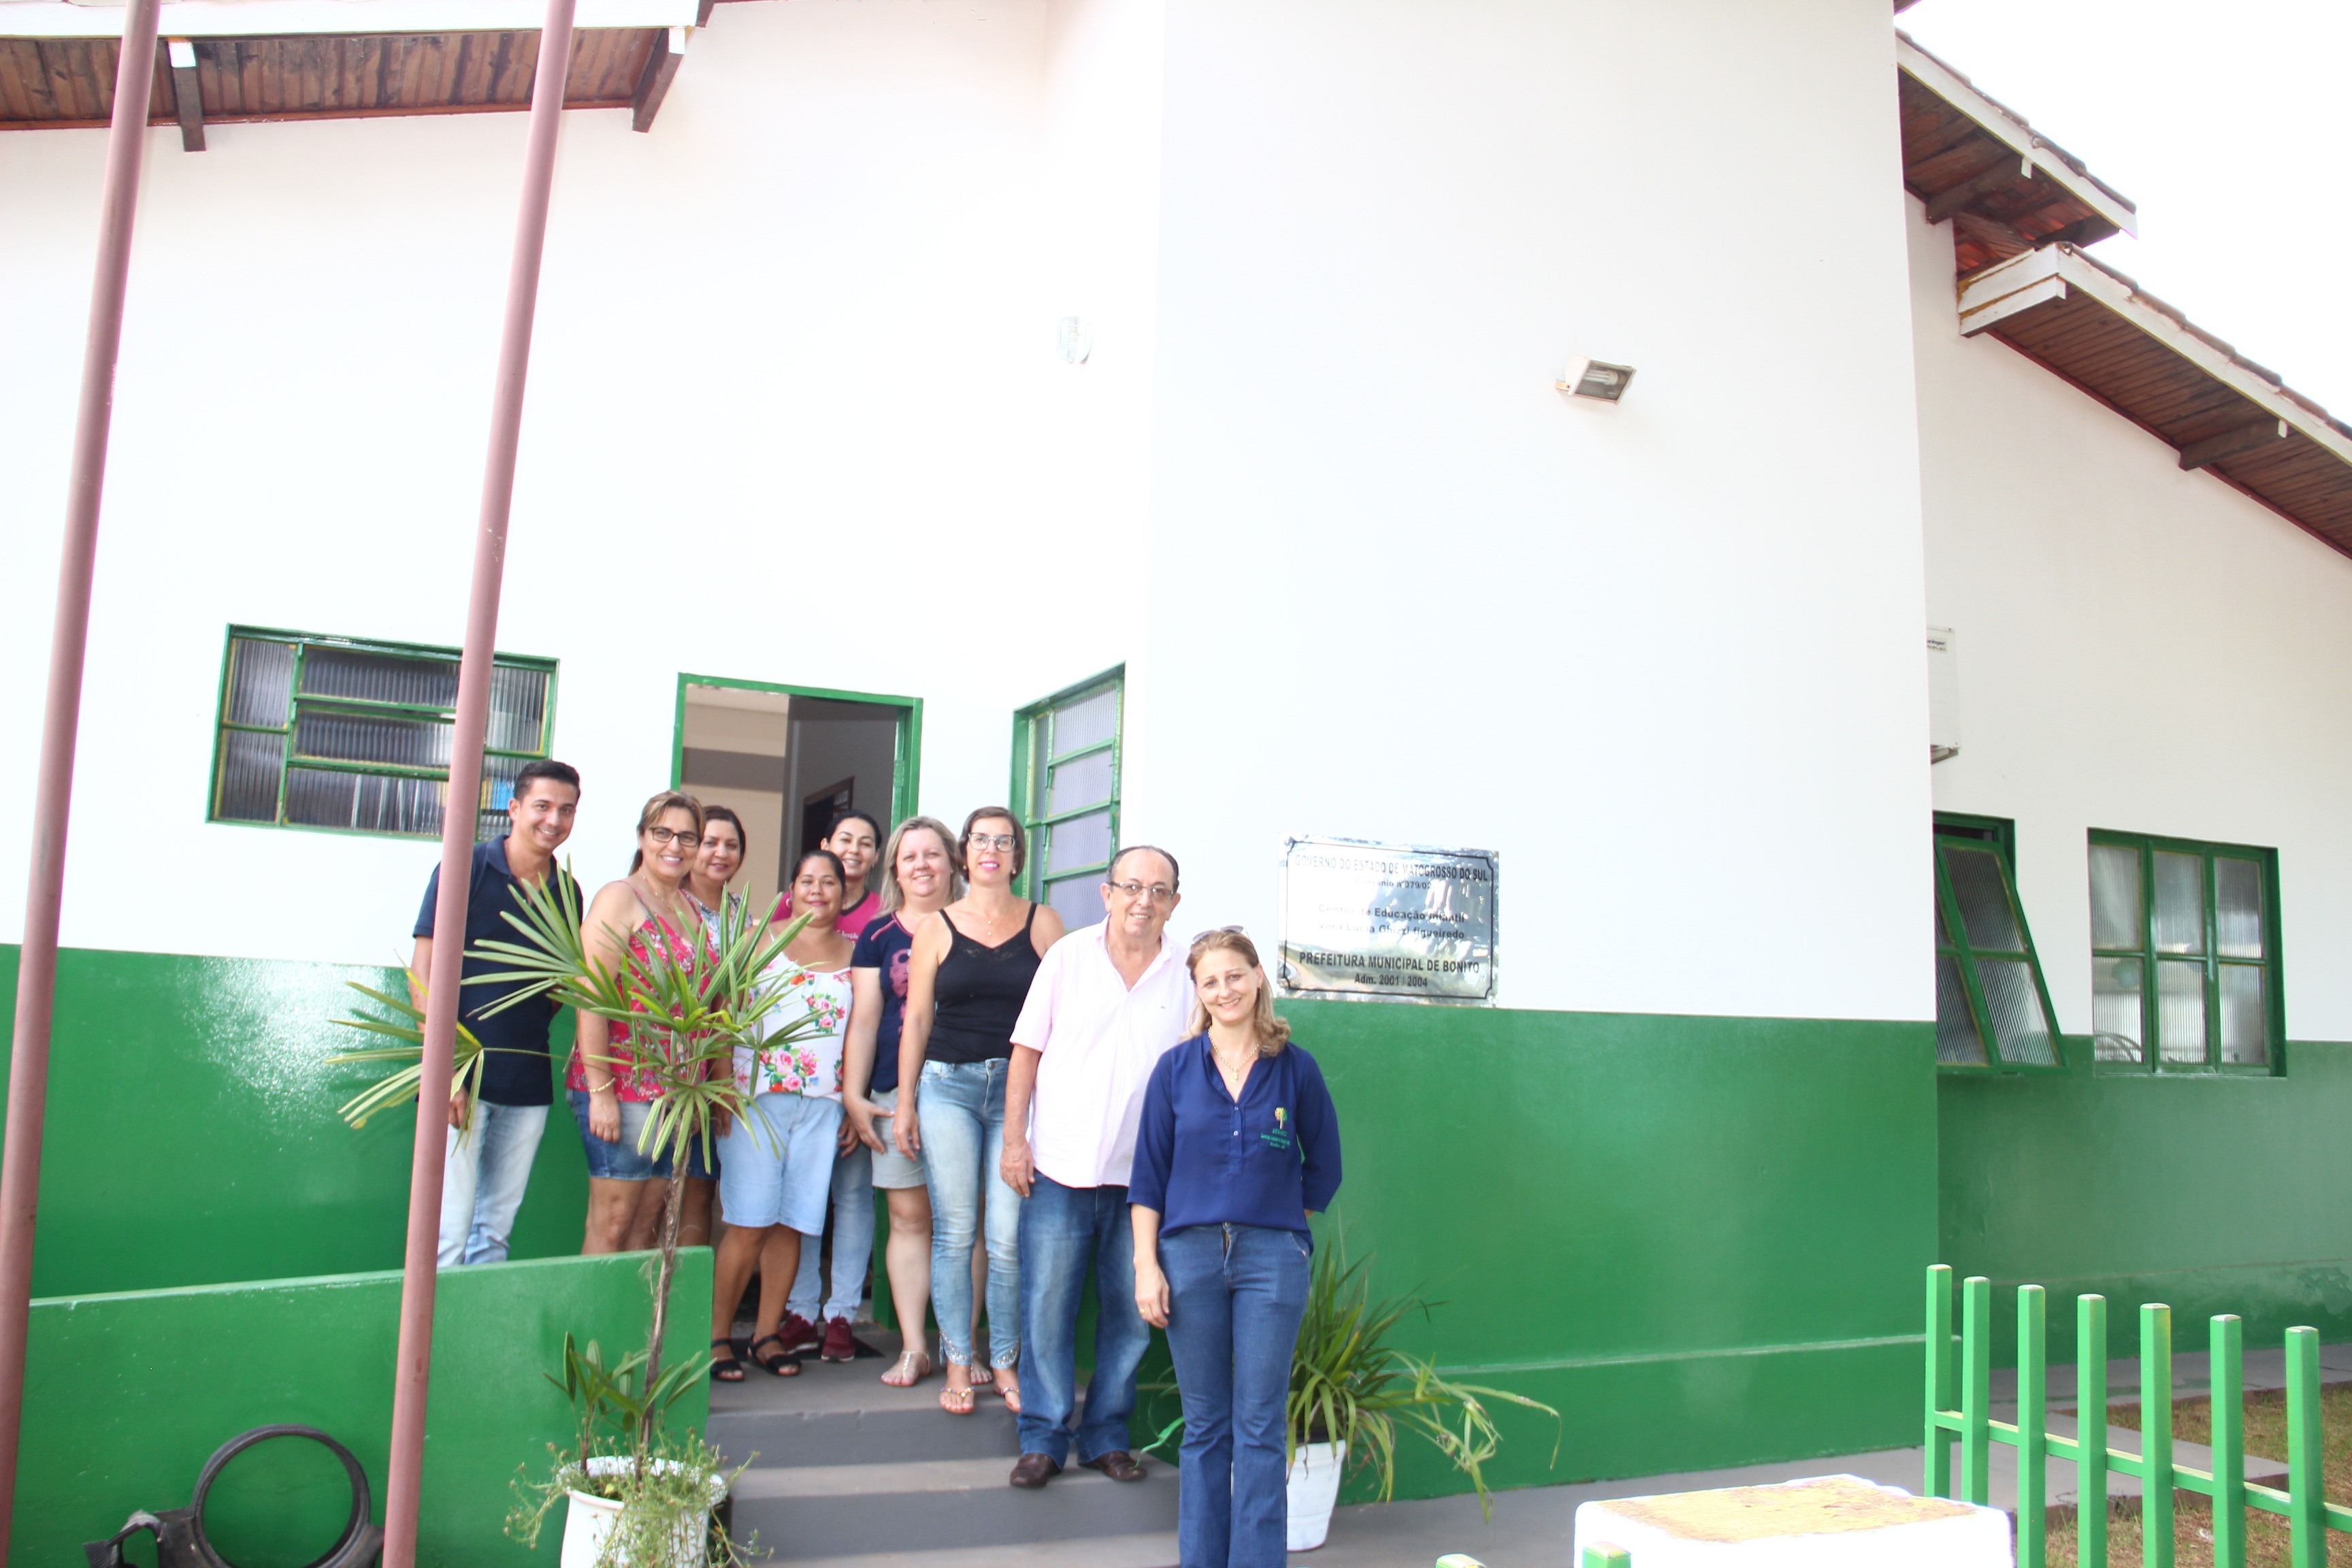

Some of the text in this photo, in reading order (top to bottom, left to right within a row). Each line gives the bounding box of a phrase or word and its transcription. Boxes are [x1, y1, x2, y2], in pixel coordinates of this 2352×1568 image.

[1295, 854, 1337, 869] GOVERNO
[1339, 858, 1351, 870] DO
[1354, 859, 1387, 874] ESTADO
[1388, 862, 1399, 875] DE
[1459, 868, 1470, 880] DO
[1472, 868, 1488, 881] SUL
[1318, 903, 1355, 915] Centro
[1358, 905, 1371, 916] de
[1374, 906, 1426, 921] Educação
[1318, 921, 1343, 932] Vera
[1413, 926, 1465, 940] figueiredo
[1299, 951, 1480, 973] PREFEITURA MUNICIPAL DE BONITO
[1354, 973, 1375, 985] Adm.
[1379, 974, 1399, 986] 2001
[1407, 976, 1428, 987] 2004
